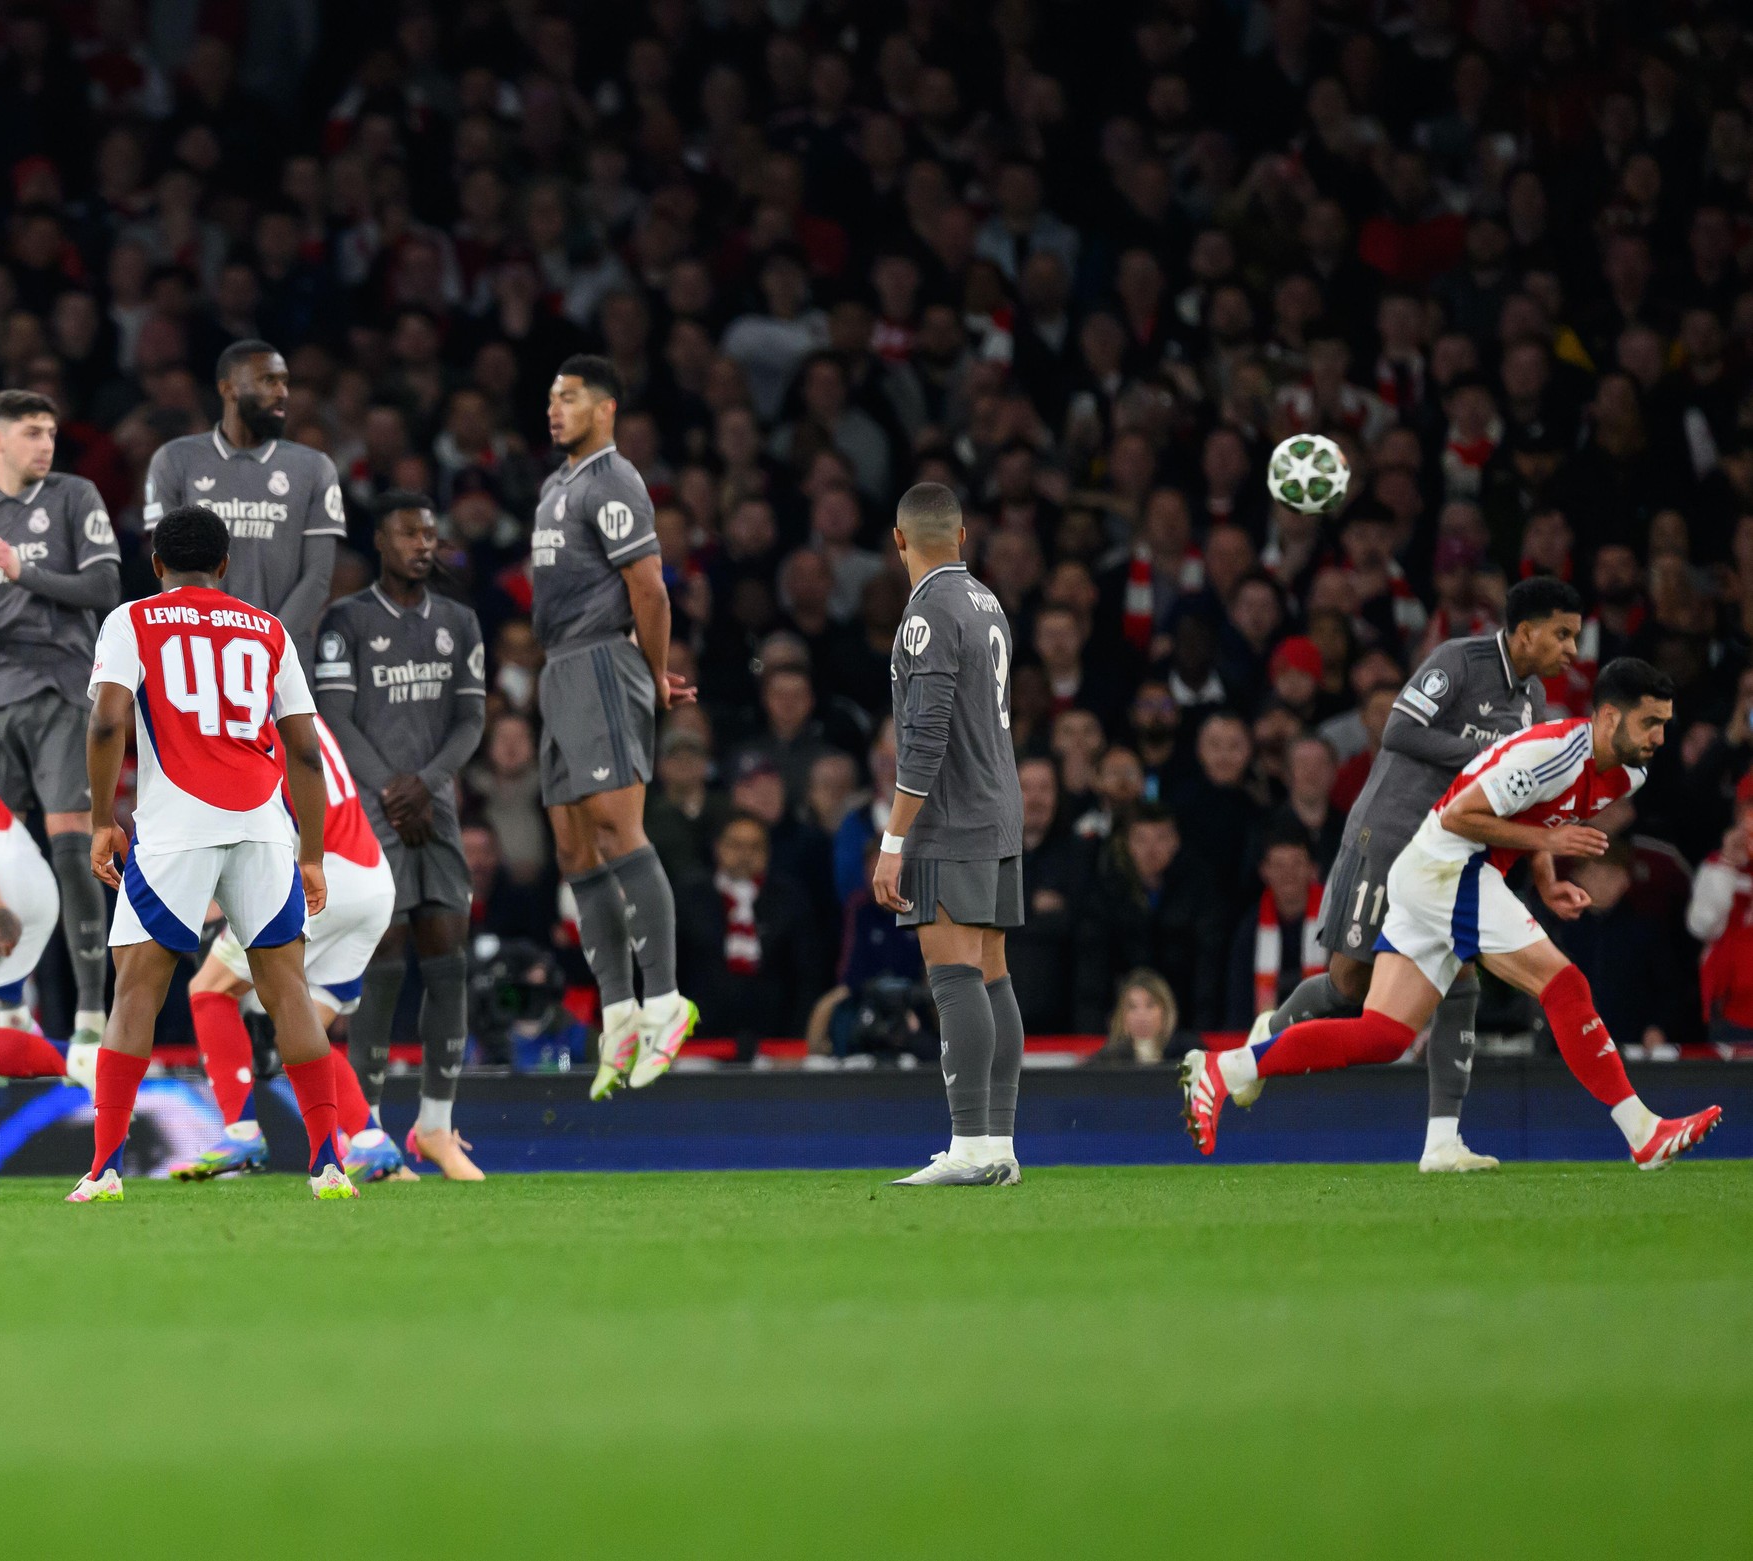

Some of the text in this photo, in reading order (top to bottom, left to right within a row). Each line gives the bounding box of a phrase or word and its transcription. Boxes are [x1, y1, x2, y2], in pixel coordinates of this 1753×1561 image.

[233, 519, 275, 539] BETTER
[602, 501, 629, 540] hp
[143, 606, 271, 635] LEWIS-SKELLY
[904, 616, 929, 656] hp
[160, 634, 271, 741] 49
[371, 659, 453, 688] Emirates
[989, 624, 1011, 730] 9
[1352, 880, 1386, 926] 11
